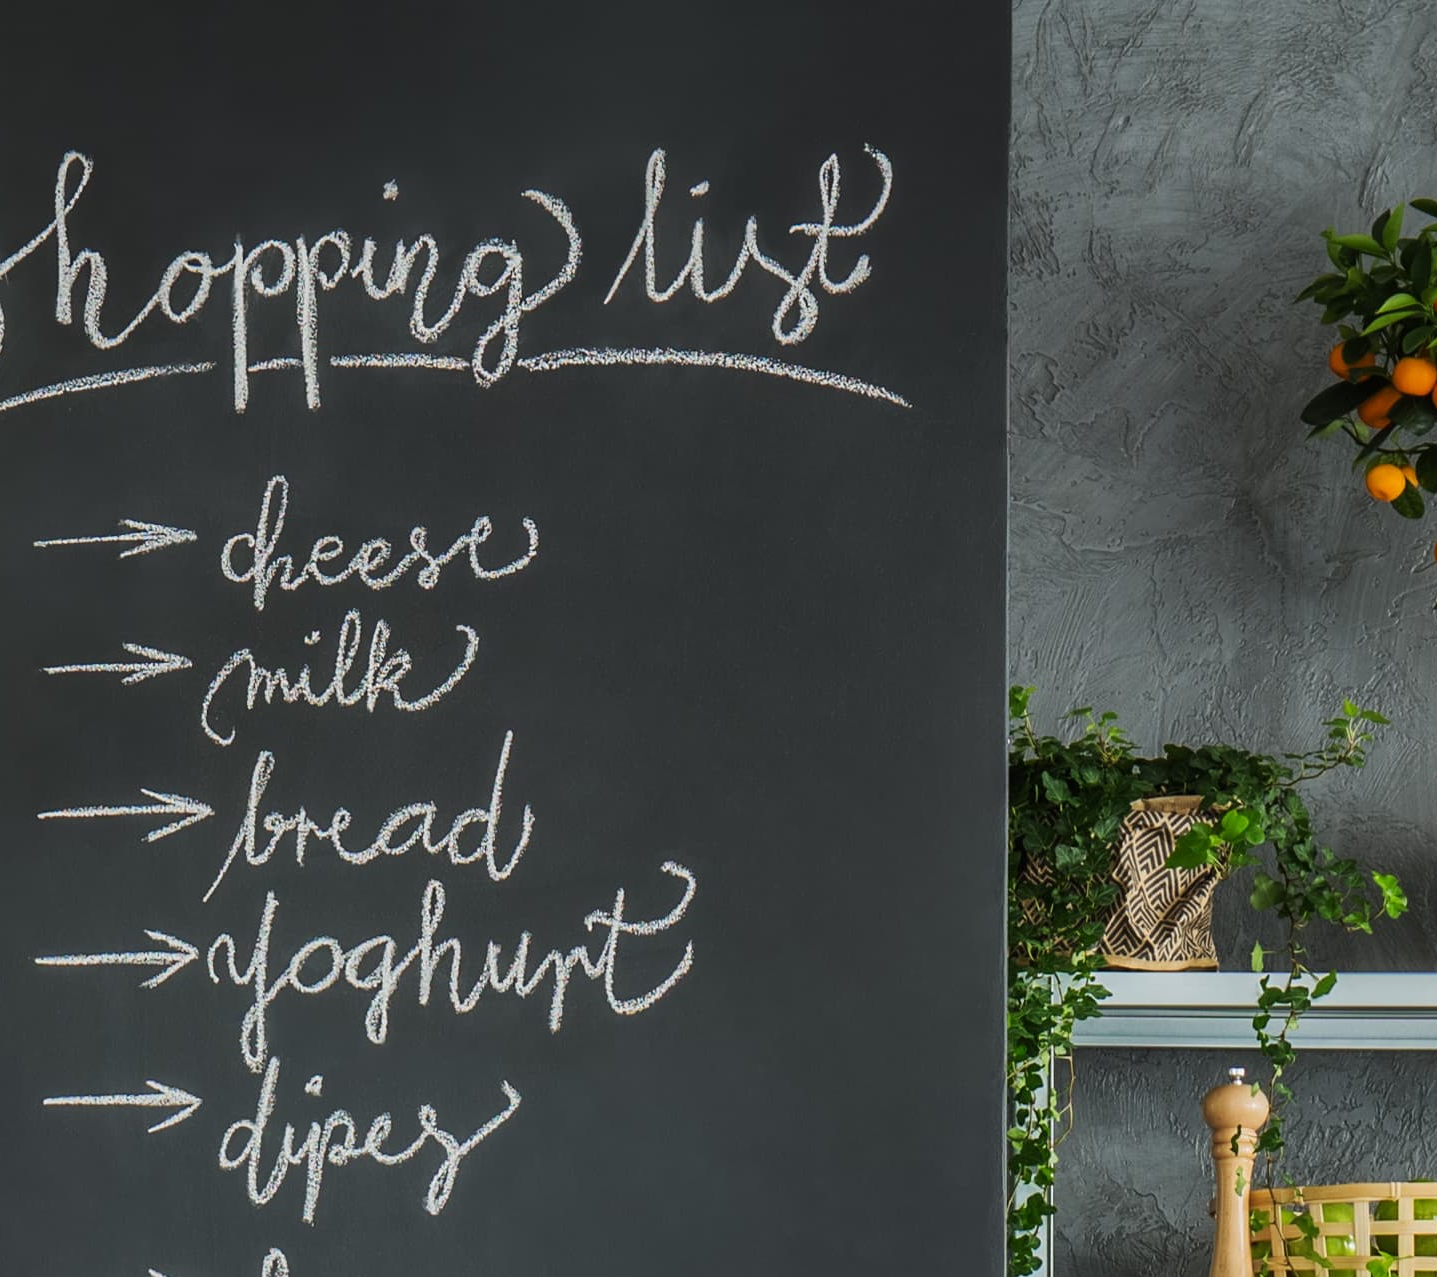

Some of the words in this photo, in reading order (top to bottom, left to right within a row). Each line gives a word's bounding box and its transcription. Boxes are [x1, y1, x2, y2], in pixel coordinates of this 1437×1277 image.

[603, 142, 893, 344] list
[220, 474, 539, 611] cheese
[201, 607, 480, 747] milk
[202, 730, 536, 903] bread
